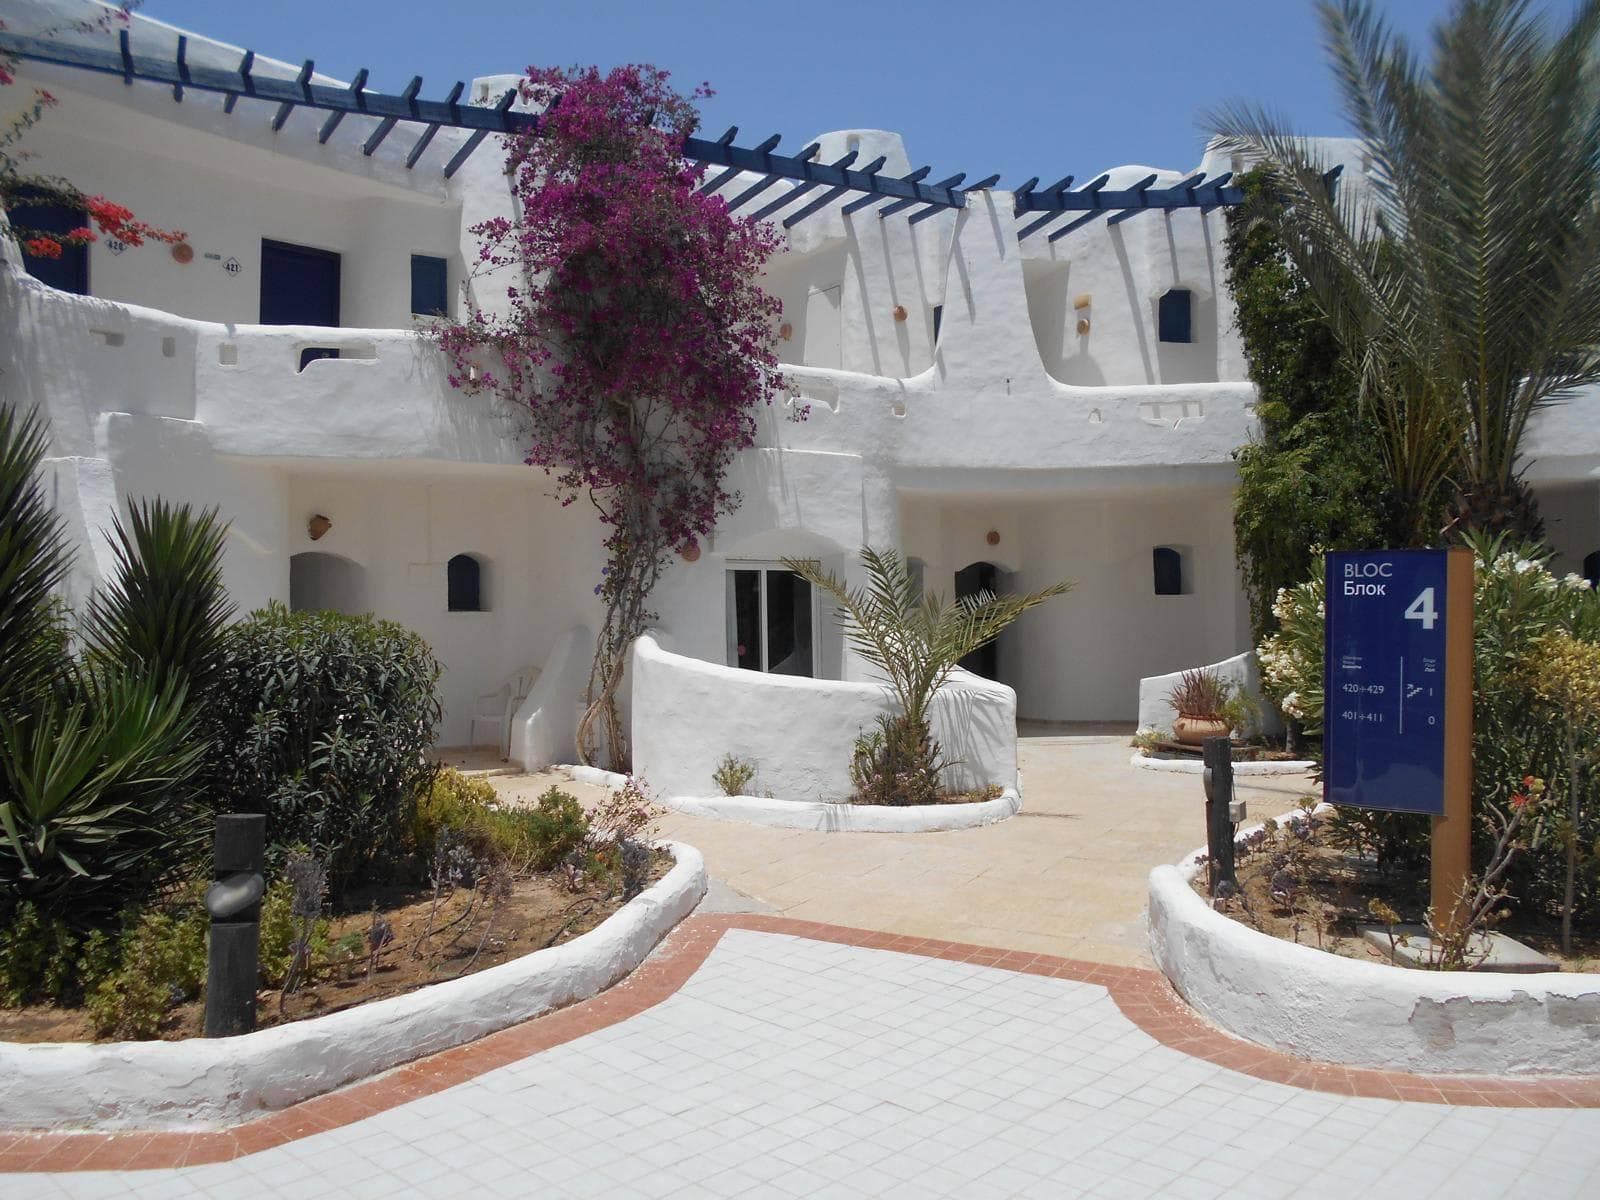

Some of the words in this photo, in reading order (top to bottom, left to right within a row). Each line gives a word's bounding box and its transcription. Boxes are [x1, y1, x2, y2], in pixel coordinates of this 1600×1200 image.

[226, 263, 239, 272] 421
[1344, 563, 1393, 578] BLOC
[1344, 581, 1386, 596] Блок
[1404, 587, 1438, 629] 4
